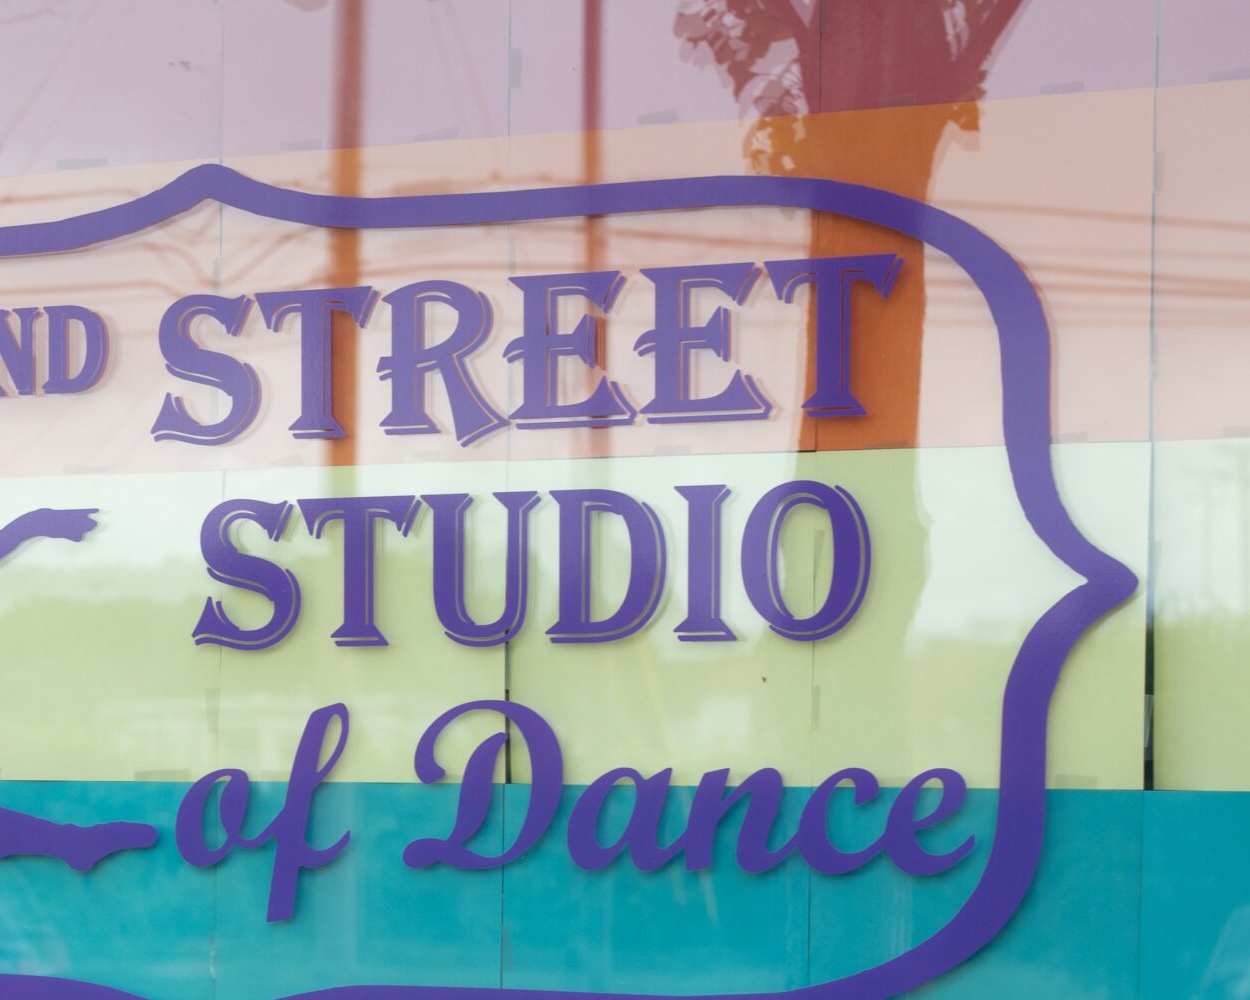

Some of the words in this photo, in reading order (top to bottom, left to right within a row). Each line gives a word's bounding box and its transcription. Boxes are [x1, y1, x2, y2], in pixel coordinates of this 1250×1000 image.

[151, 254, 903, 446] STREET
[192, 480, 871, 648] STUDIO
[176, 702, 351, 923] of
[402, 700, 976, 876] Dance
